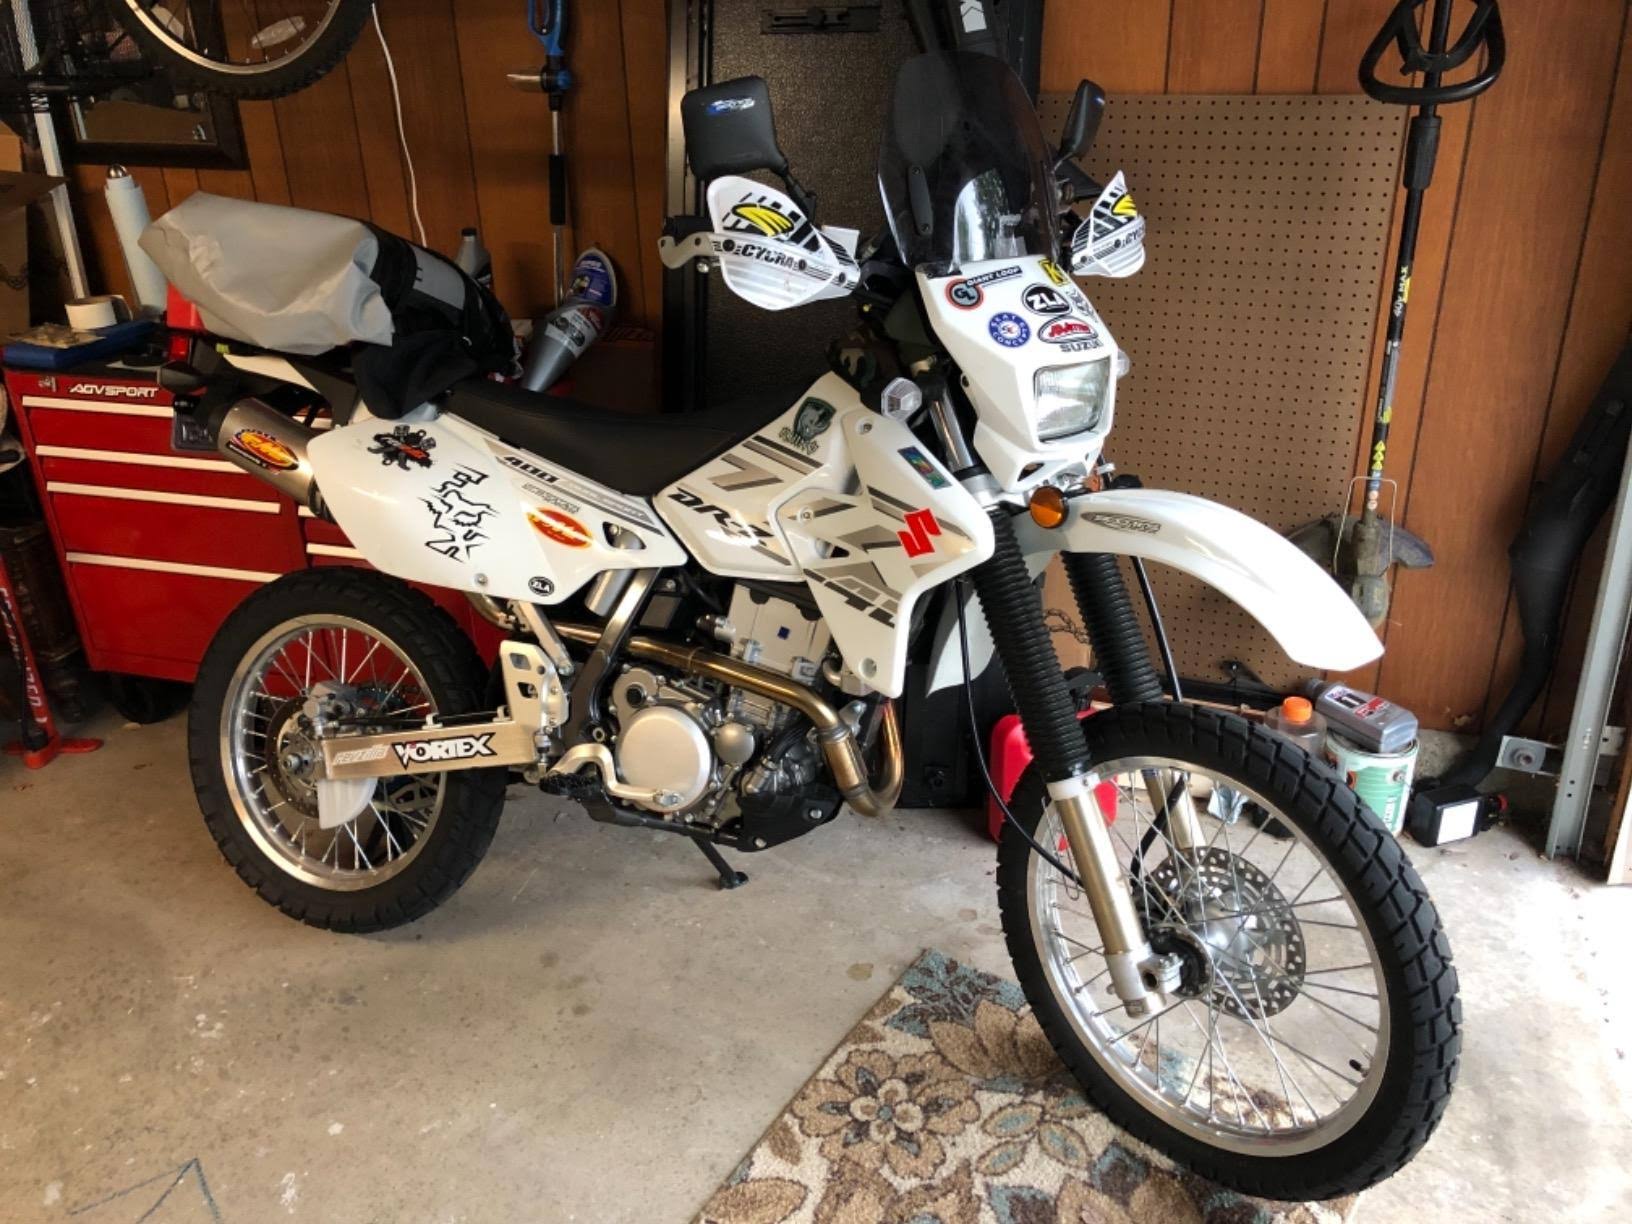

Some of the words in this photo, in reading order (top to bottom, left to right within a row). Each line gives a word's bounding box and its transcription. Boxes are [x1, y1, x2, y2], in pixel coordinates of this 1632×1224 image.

[741, 243, 795, 269] CYCRA
[966, 273, 993, 286] GIANT
[995, 266, 1019, 279] LOOP
[1398, 264, 1409, 292] MAX
[70, 383, 159, 398] AGVSPORT
[503, 456, 560, 484] 400
[530, 579, 551, 592] ZLA
[392, 733, 496, 769] VORTEX
